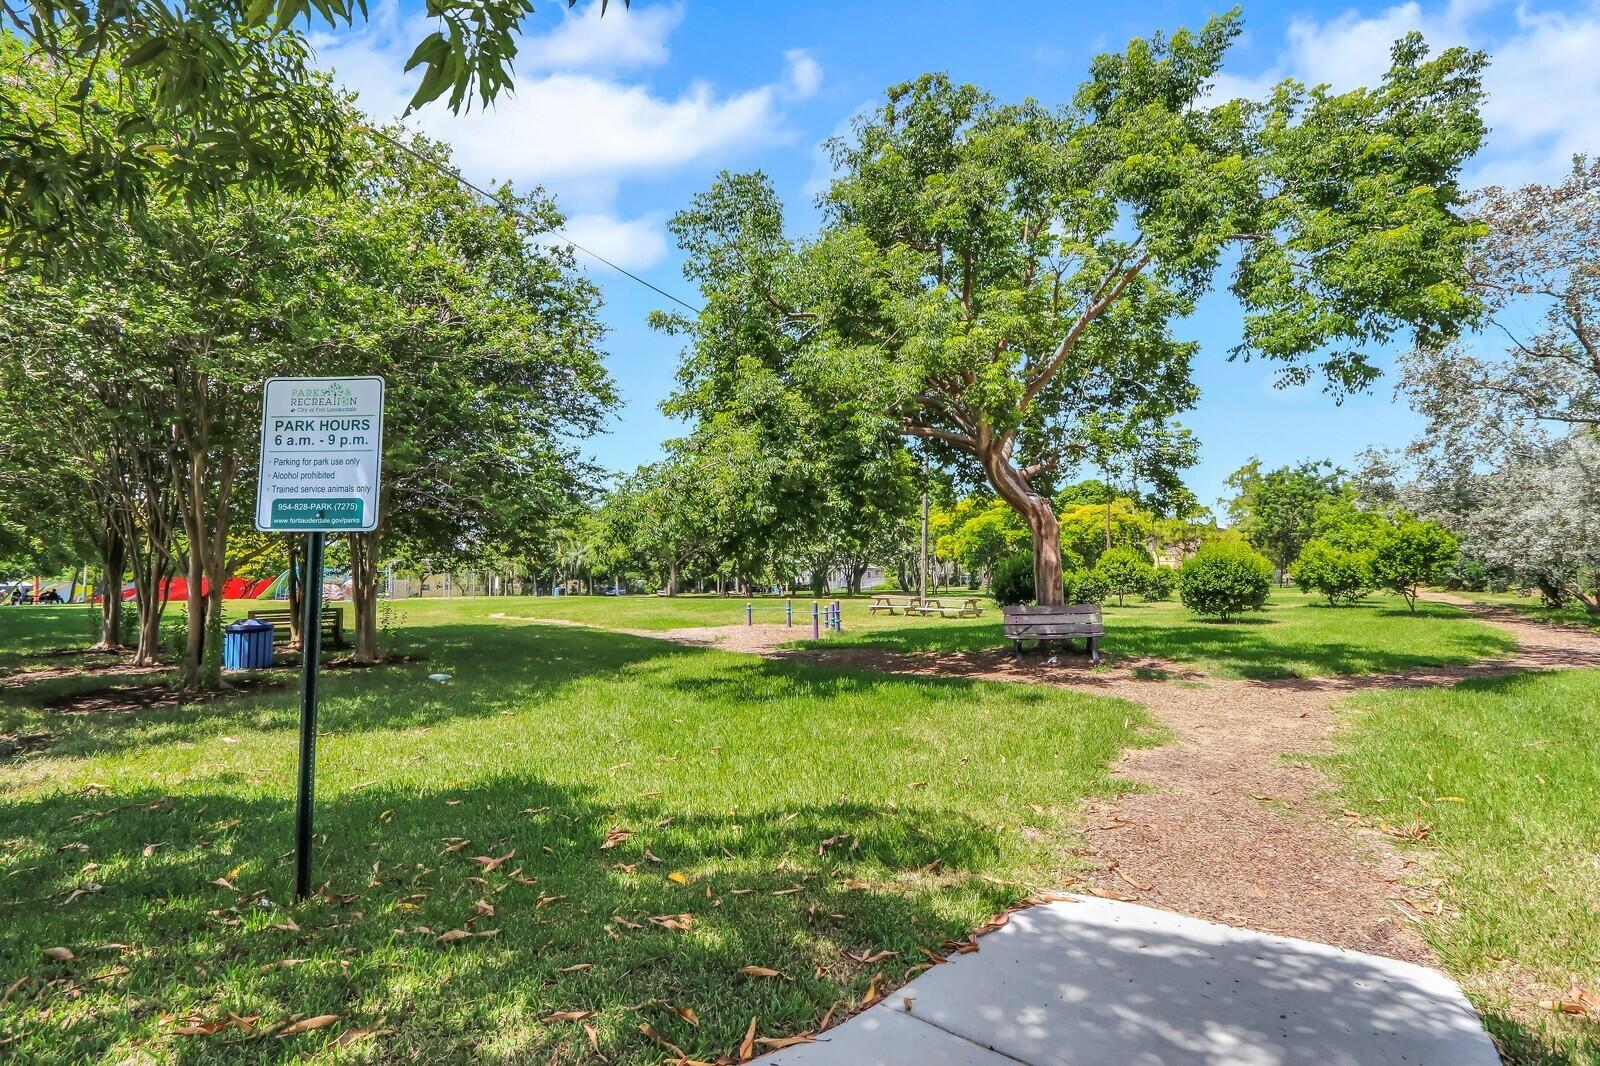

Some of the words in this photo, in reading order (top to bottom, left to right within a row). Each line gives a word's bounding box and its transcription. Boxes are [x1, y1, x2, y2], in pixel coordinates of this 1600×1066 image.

[291, 389, 326, 397] PARKS
[275, 420, 315, 432] PARK
[319, 419, 370, 431] HOURS
[274, 434, 283, 446] 6
[286, 436, 315, 446] a.m.
[328, 434, 336, 445] 9
[340, 436, 369, 448] p.m.
[273, 458, 300, 467] Parking
[302, 457, 312, 466] for
[313, 457, 329, 467] park
[345, 457, 360, 467] only
[272, 471, 299, 480] Alcohol
[300, 471, 336, 481] prohibited
[272, 484, 299, 493] Trained
[300, 485, 326, 493] service
[327, 484, 354, 493] animals
[356, 484, 371, 494] only
[277, 503, 333, 511] 954-828-PARK
[334, 502, 358, 512] (7275)
